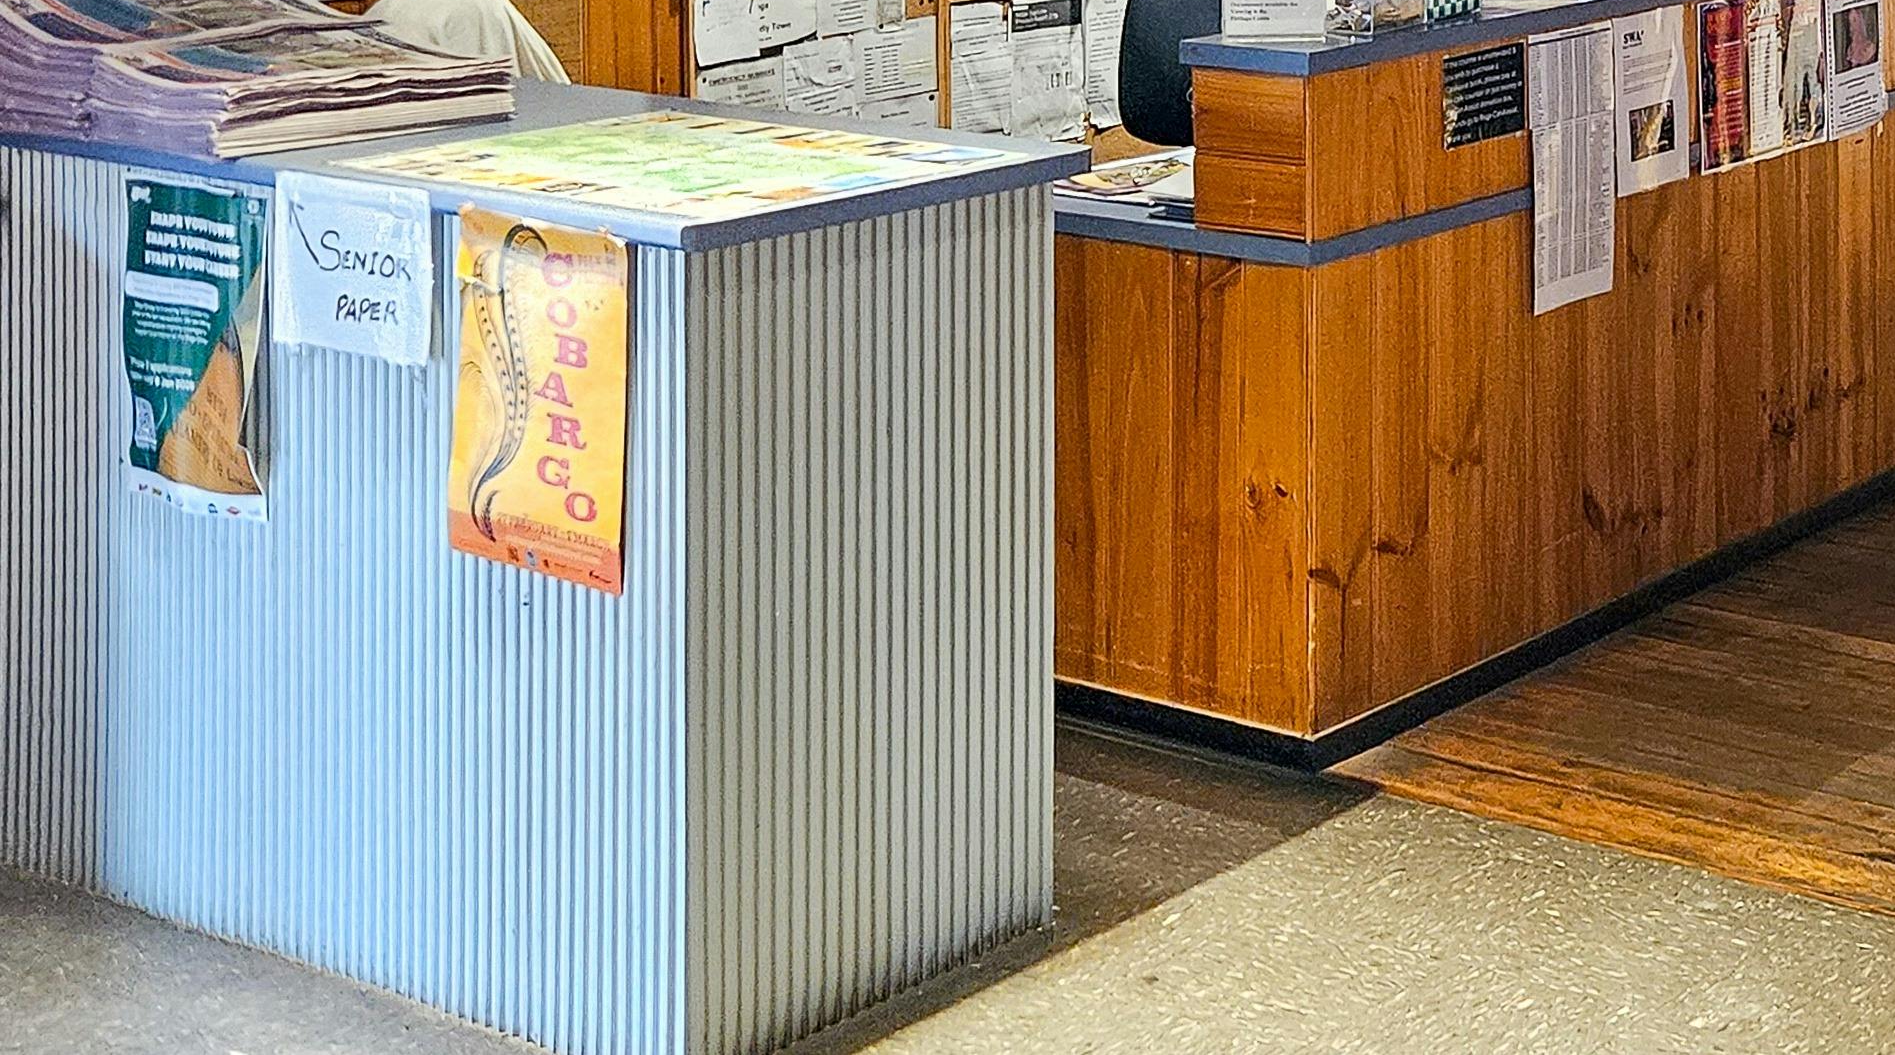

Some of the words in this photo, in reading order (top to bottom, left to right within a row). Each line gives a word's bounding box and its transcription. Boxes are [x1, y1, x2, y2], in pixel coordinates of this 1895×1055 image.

[320, 230, 411, 281] SENIOR
[336, 294, 399, 326] PAPER
[534, 253, 598, 522] COBARGO
